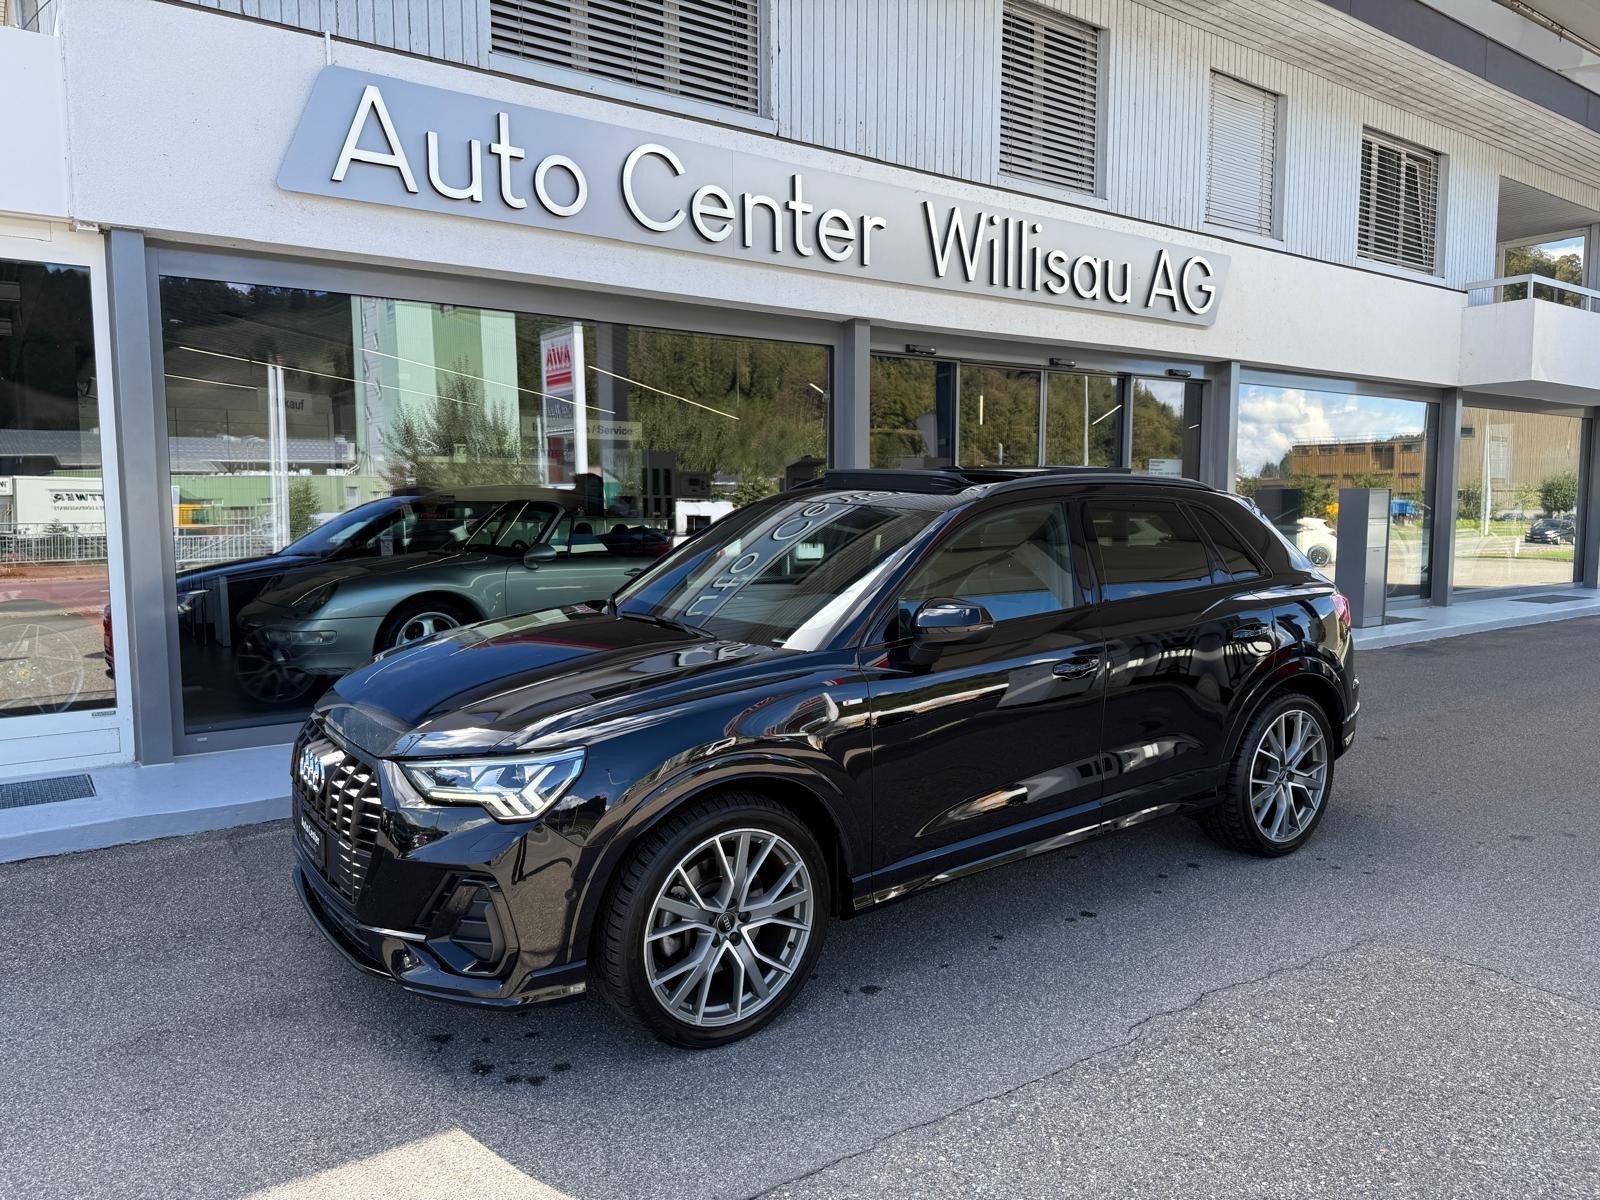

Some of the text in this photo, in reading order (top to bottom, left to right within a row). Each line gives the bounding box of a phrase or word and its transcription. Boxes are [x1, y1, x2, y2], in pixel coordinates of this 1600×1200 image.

[330, 84, 1217, 316] Auto Center Willisau AG
[597, 425, 633, 436] Service
